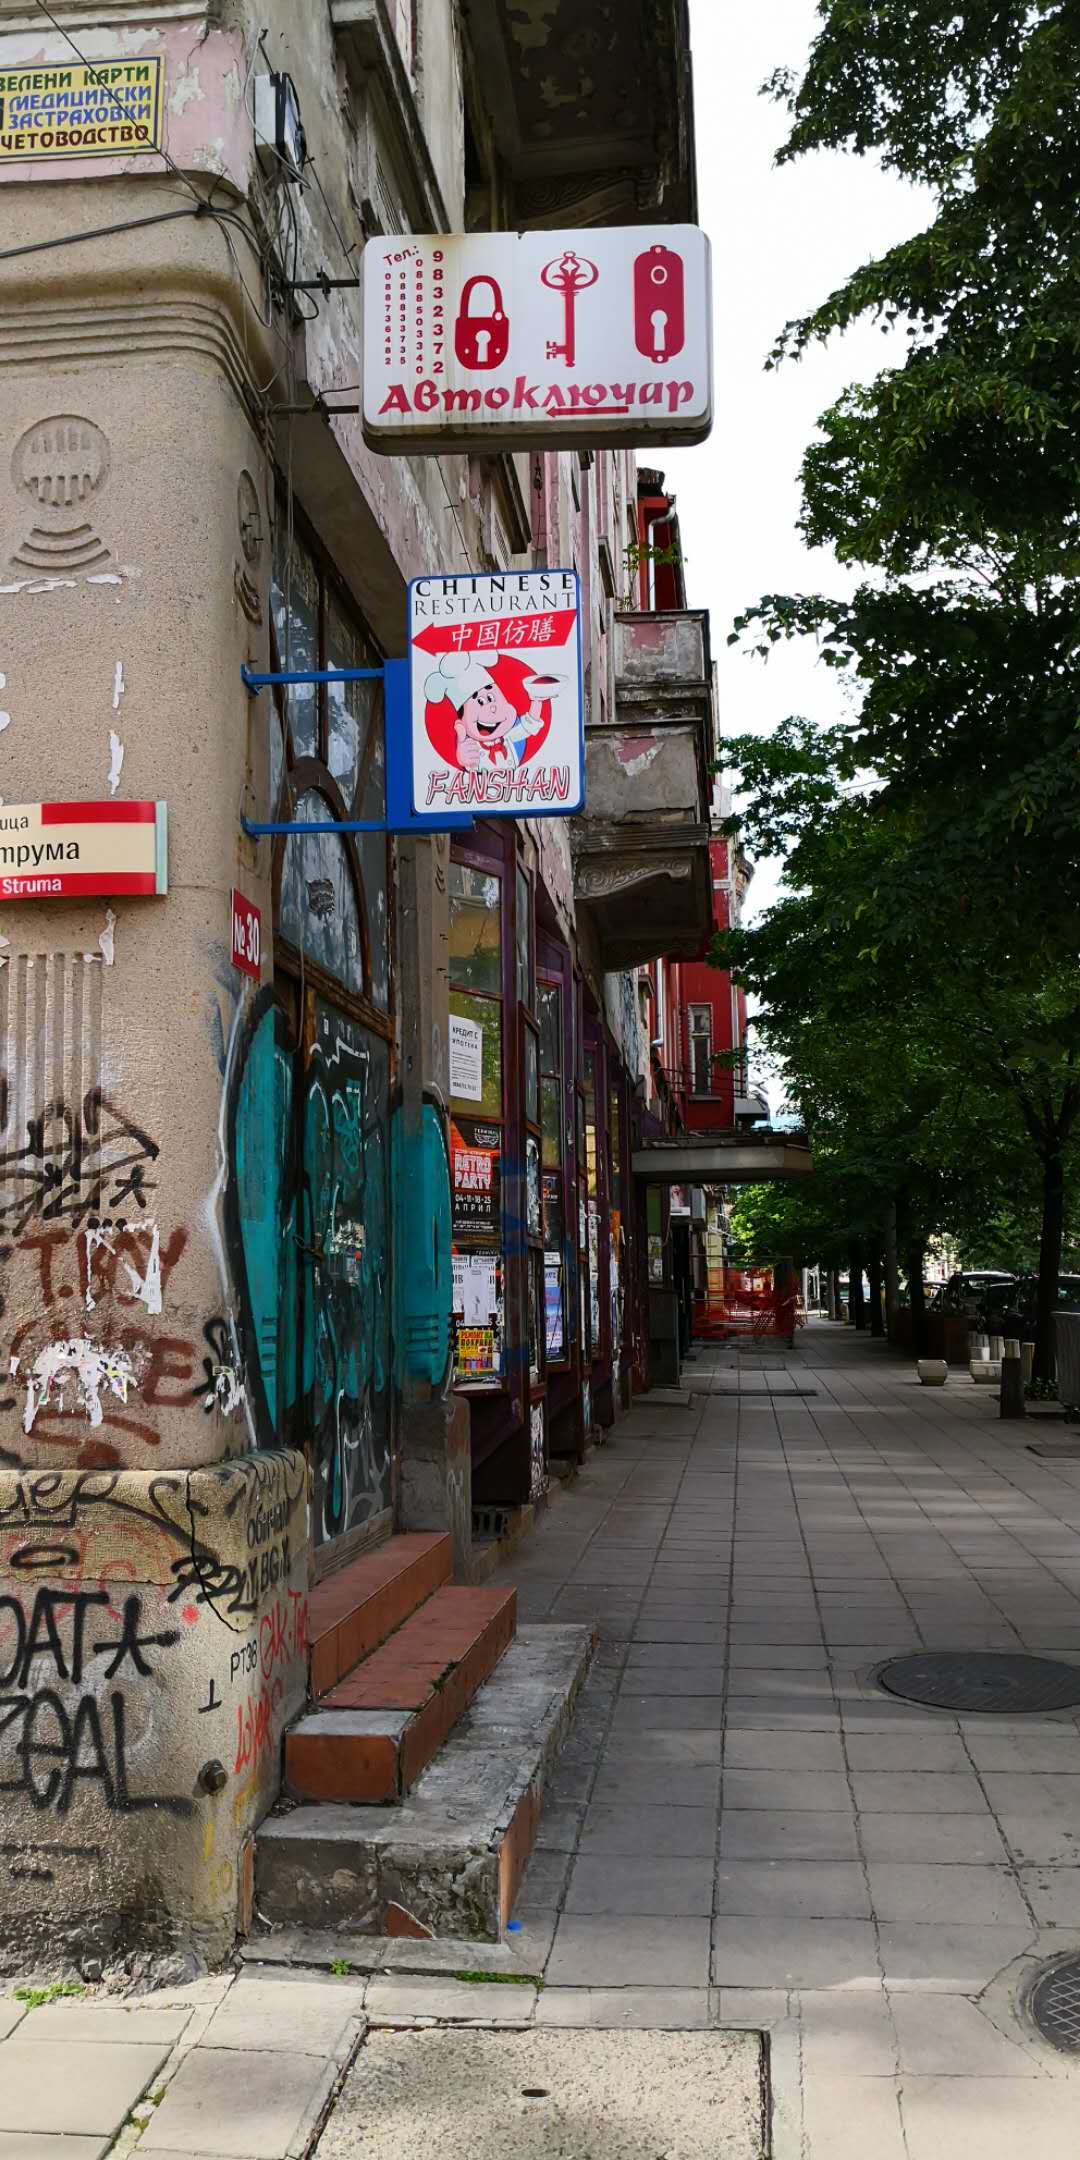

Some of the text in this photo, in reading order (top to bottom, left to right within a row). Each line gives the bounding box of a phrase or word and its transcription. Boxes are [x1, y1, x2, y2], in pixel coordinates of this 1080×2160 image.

[84, 66, 149, 86] КАРТИ
[9, 85, 152, 112] МЕДИЦИНСКИ
[8, 104, 150, 130] ЗАСТРАХОВКИ
[433, 250, 444, 374] 9832372
[378, 376, 694, 414] Автоключар
[416, 573, 574, 597] CHINESE
[415, 592, 575, 615] RESTAURANT
[452, 616, 556, 651] 中国仿膳
[425, 765, 570, 805] FANSHAN
[2, 878, 62, 894] Struma
[247, 912, 259, 967] 30
[455, 1153, 491, 1173] RETRO
[455, 1171, 491, 1189] PARTY
